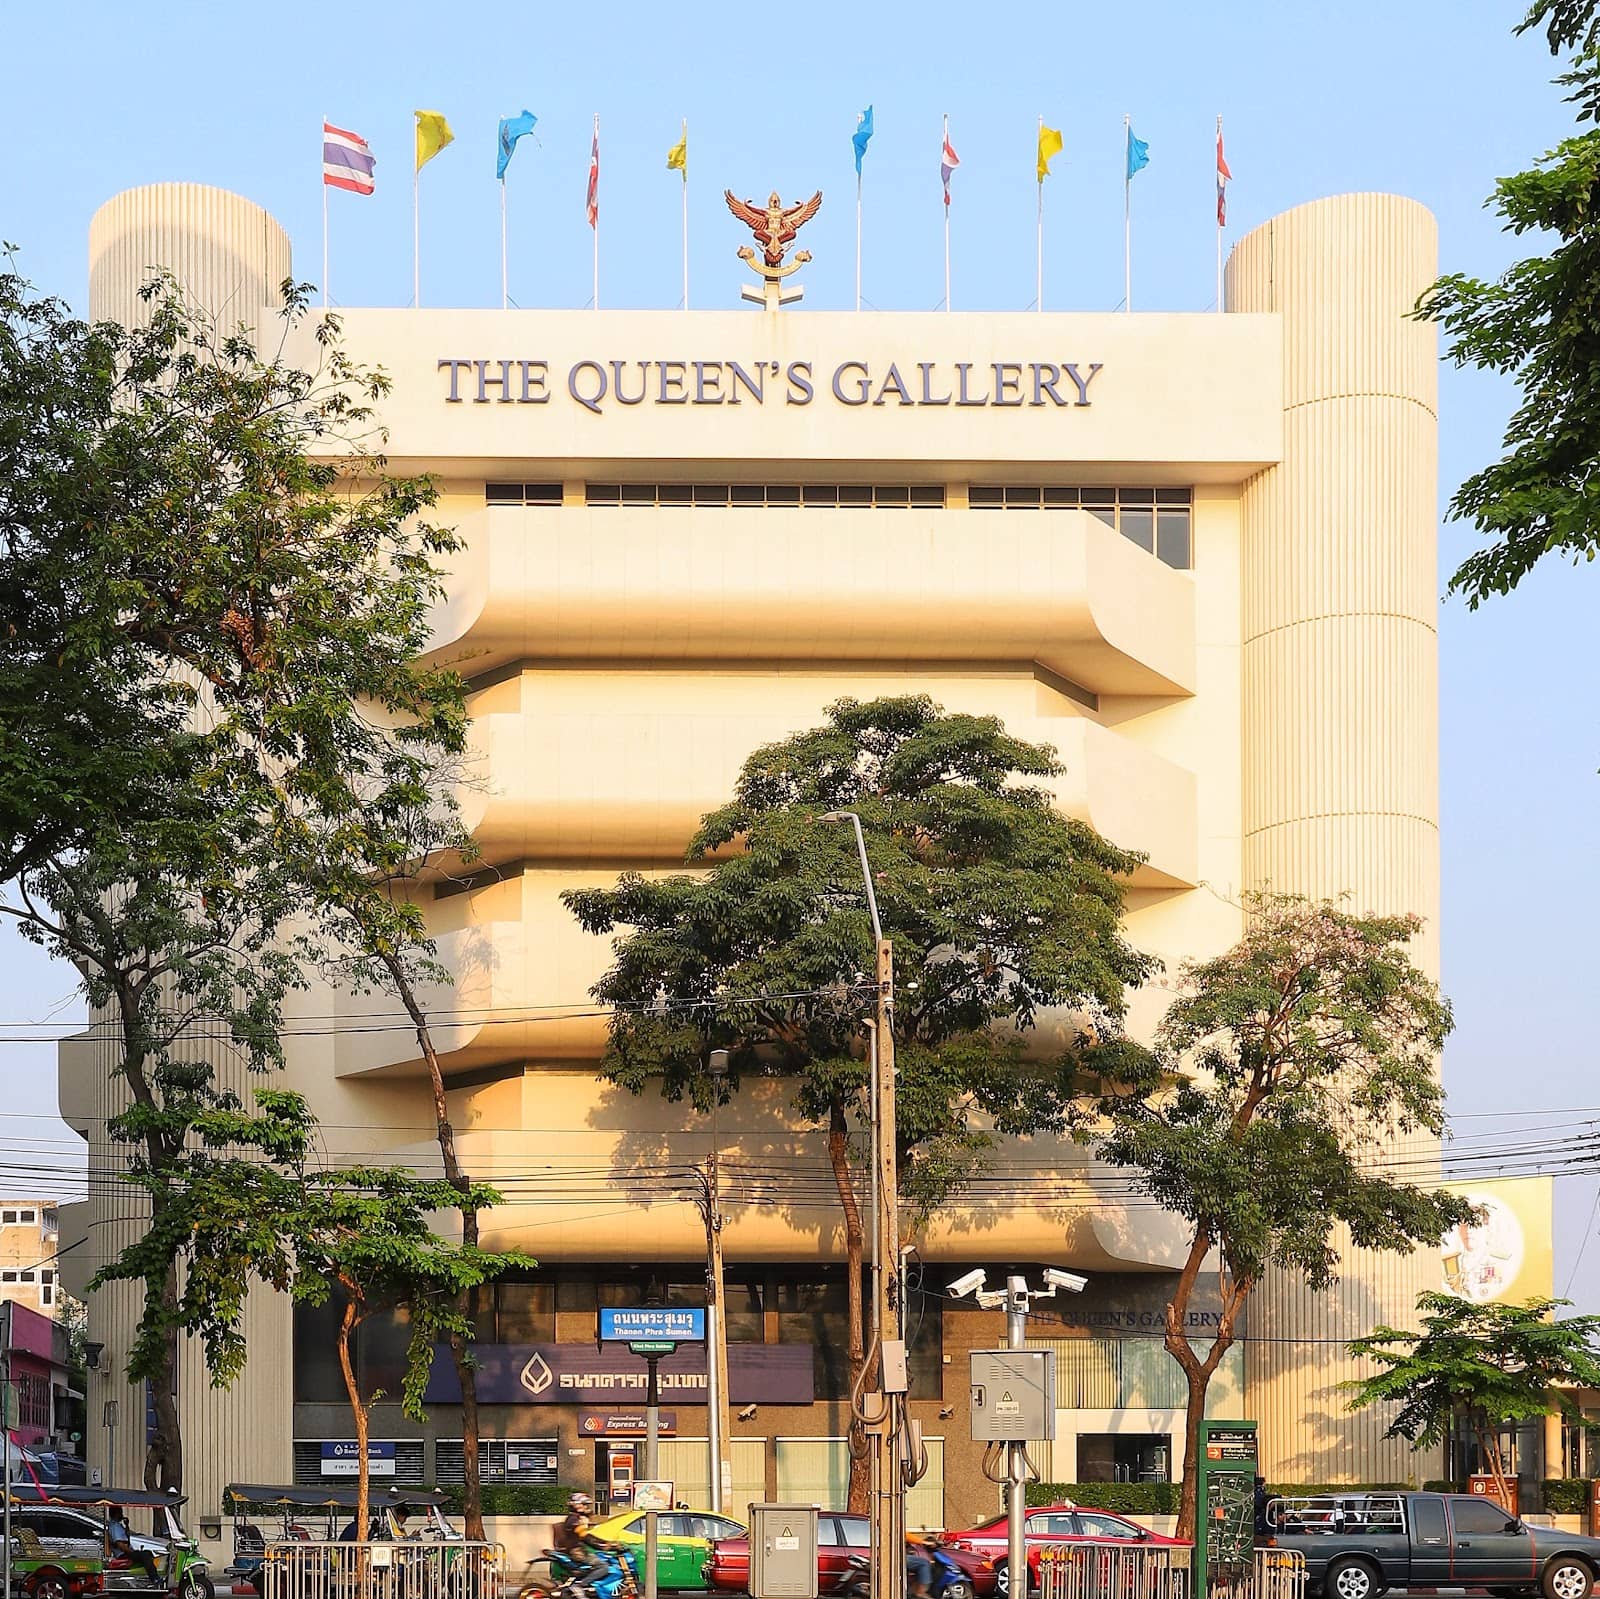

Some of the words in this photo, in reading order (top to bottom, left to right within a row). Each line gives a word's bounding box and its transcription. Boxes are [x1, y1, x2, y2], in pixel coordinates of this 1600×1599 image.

[437, 359, 551, 404] THE
[567, 360, 814, 415] QUEEN'S
[831, 361, 1104, 407] GALLERY
[613, 1313, 693, 1328] ถนนพระสุเมรุ
[1140, 1312, 1225, 1327] GAERY
[607, 1421, 636, 1429] Express
[638, 1421, 669, 1429] Bang
